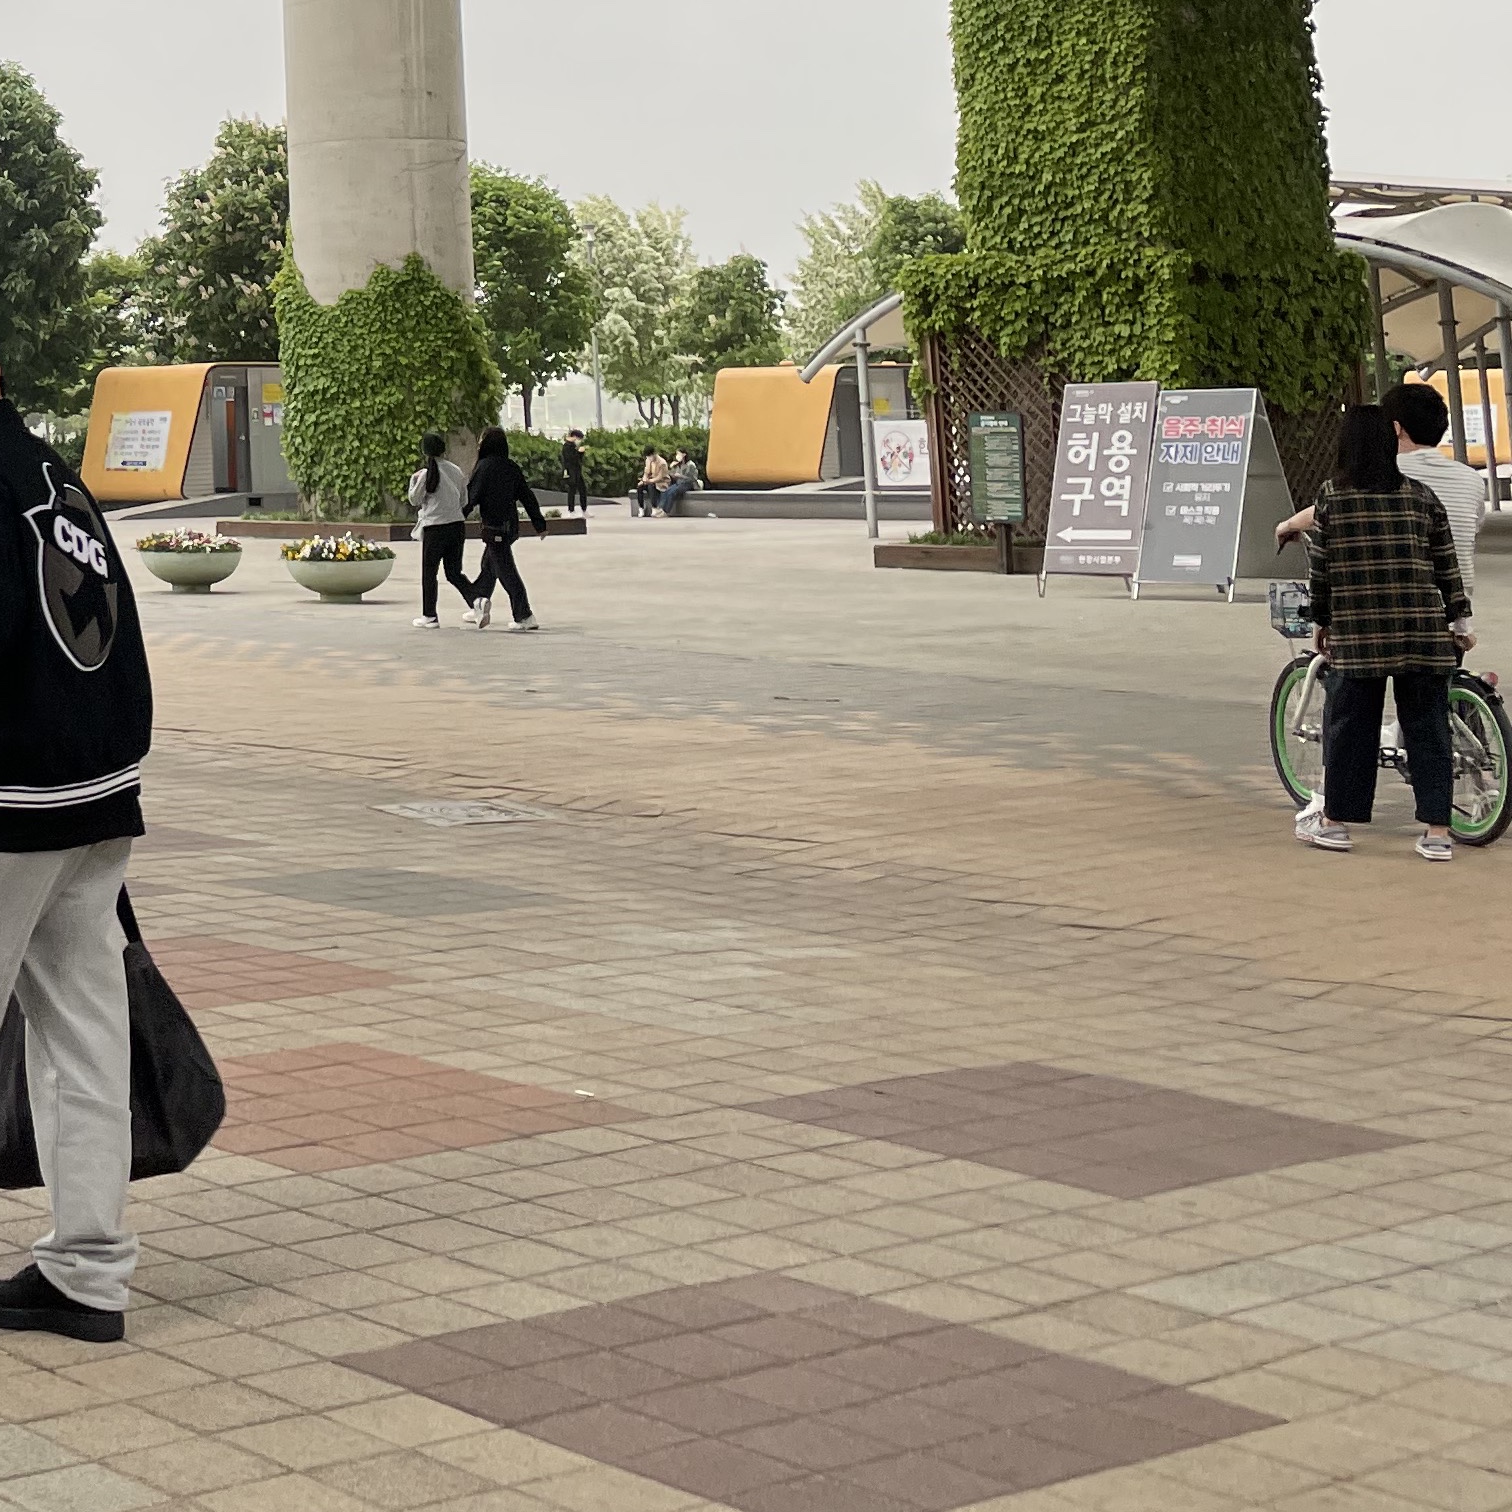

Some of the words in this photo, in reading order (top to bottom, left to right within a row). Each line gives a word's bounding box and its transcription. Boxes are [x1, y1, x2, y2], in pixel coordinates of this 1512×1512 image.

[1066, 402, 1113, 425] 그늘막
[1117, 401, 1148, 424] 설치
[1067, 431, 1137, 473] 허용
[1159, 441, 1200, 464] 자제
[1202, 441, 1241, 464] 안내
[1060, 475, 1132, 517] 구역
[54, 515, 109, 578] CDG
